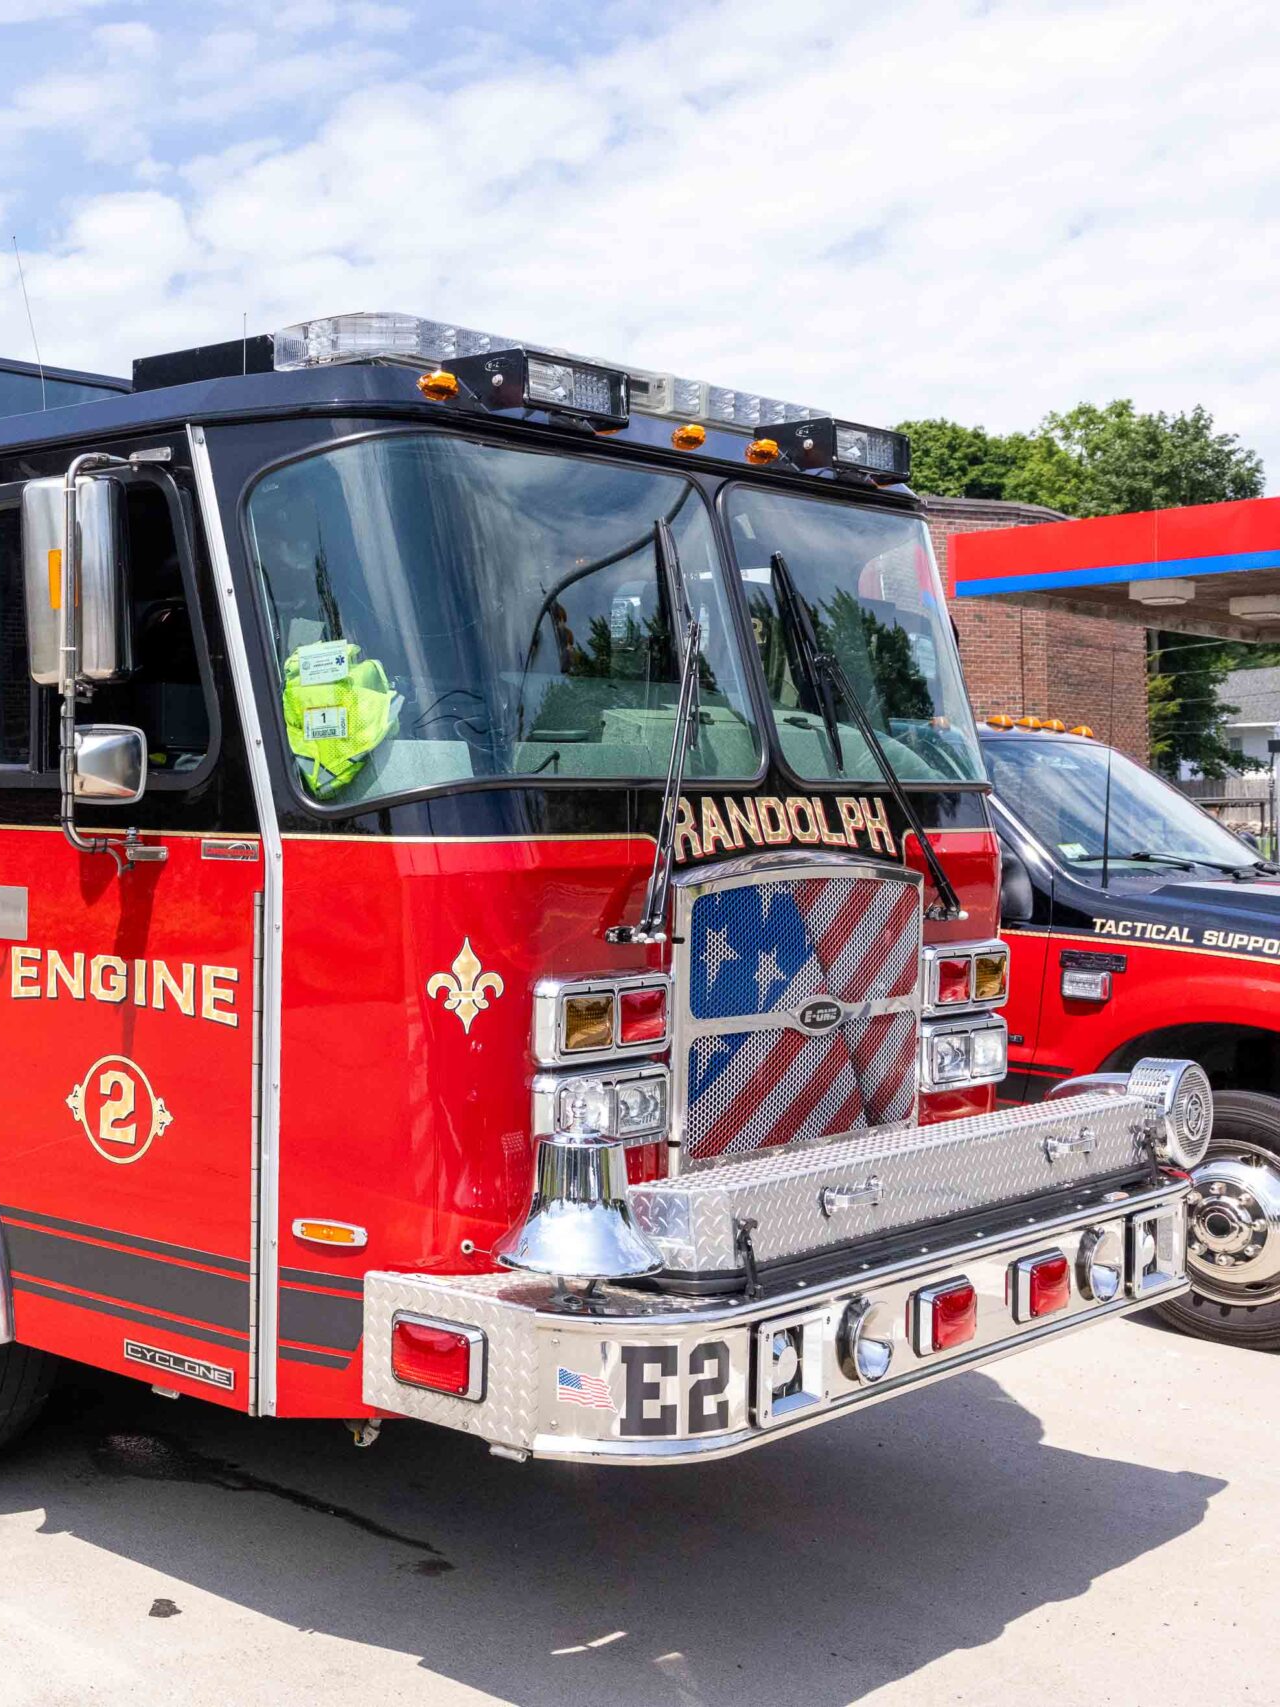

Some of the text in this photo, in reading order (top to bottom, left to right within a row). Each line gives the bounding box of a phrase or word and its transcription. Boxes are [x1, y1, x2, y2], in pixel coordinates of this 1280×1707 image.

[321, 712, 327, 724] 1
[663, 796, 898, 864] RANDOLPH
[1092, 918, 1280, 955] TACTICAL SUPPO
[11, 946, 239, 1028] ENGINE
[99, 1070, 137, 1145] 2
[127, 1344, 230, 1385] CYCLONE
[620, 1340, 730, 1437] E2
